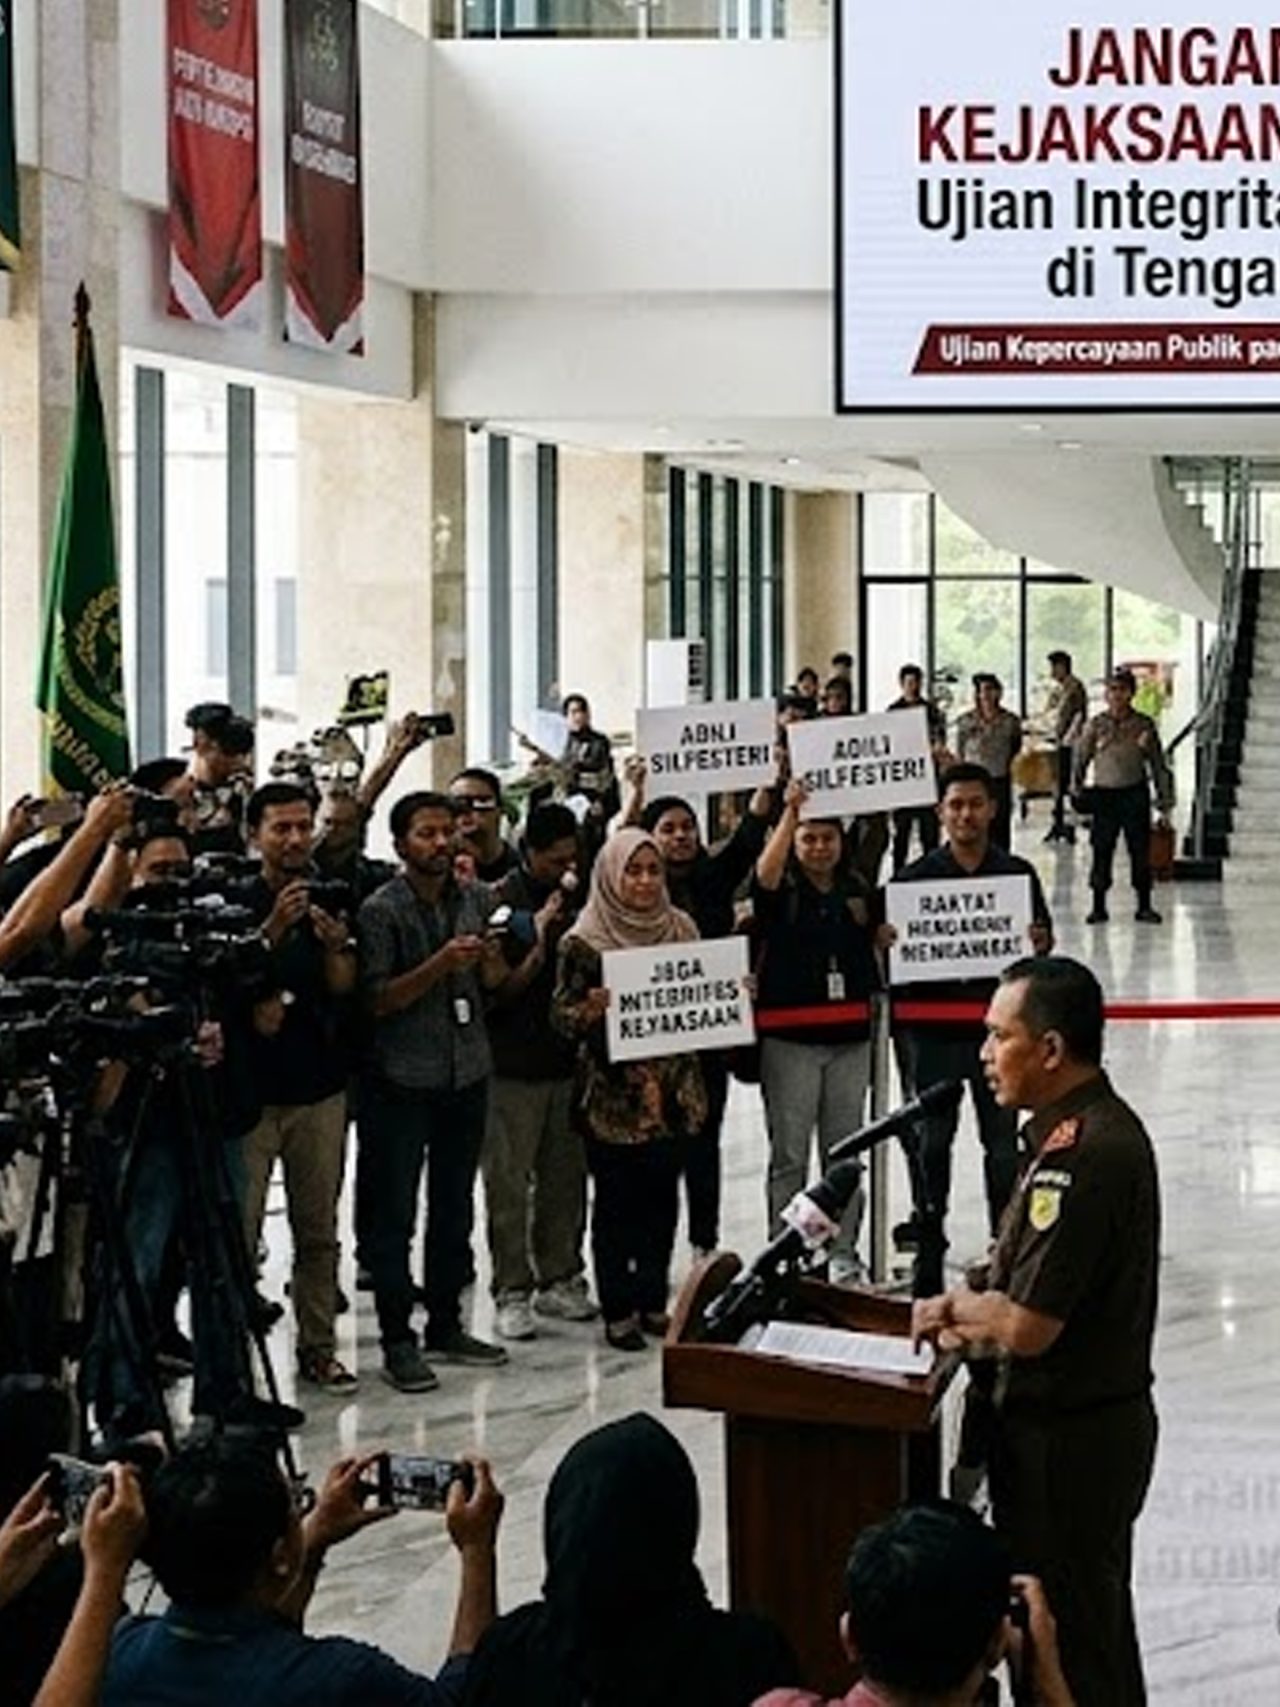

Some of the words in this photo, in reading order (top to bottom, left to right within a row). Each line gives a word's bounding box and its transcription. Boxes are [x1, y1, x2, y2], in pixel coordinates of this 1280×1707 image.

[918, 178, 1053, 241] Ujian
[1047, 246, 1094, 298] di
[940, 334, 1001, 364] Ujian
[1006, 334, 1161, 364] Kepercayaan
[1167, 333, 1243, 360] Publik
